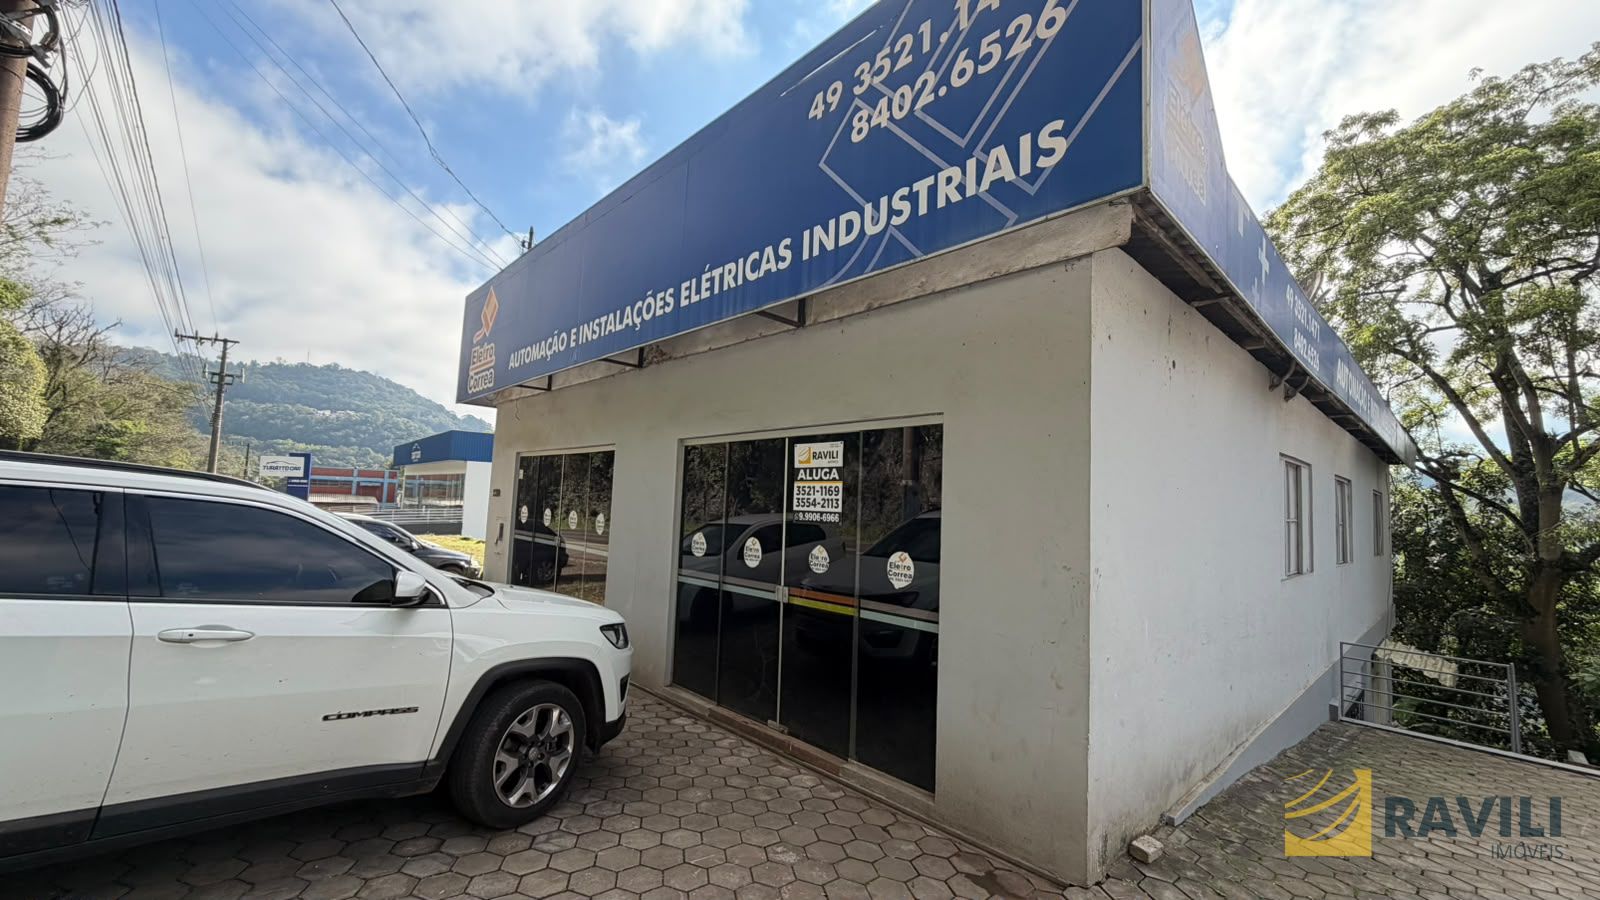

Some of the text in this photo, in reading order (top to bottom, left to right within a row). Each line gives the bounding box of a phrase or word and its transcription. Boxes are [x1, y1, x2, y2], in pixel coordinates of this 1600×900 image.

[851, 0, 1067, 143] 8402.6526
[808, 80, 843, 120] 49
[508, 119, 1067, 370] AUTOMAÇÃO E INSTALAÇÕES ELÉTRICAS INDUSTRIAIS
[471, 342, 495, 366] Eletro
[467, 368, 494, 393] Correa
[812, 450, 839, 461] RAVILI
[797, 468, 840, 480] ALUGA
[795, 485, 840, 497] 3521-1169
[795, 497, 840, 509] 3554-2113
[888, 569, 913, 579] Correa
[322, 706, 419, 721] COMPASS
